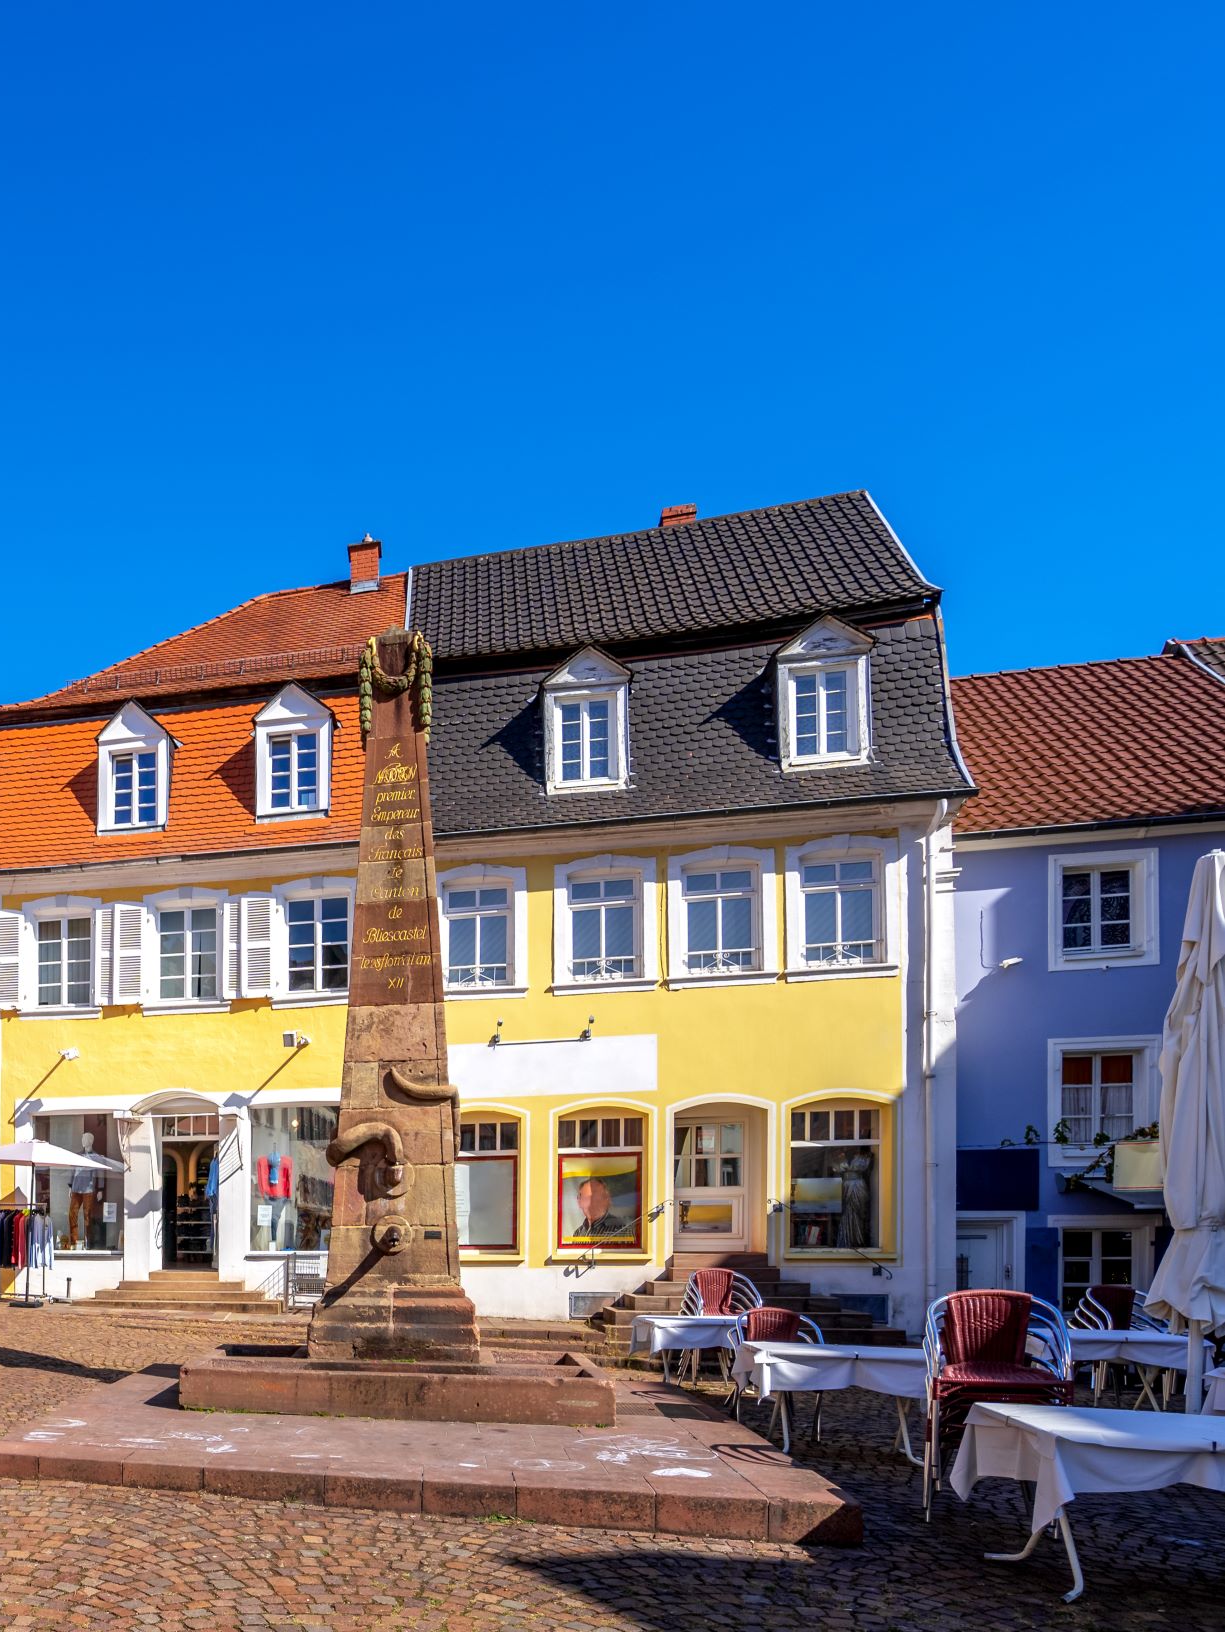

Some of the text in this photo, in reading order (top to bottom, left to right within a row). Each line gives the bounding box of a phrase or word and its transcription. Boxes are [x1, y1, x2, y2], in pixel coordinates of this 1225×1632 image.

[370, 806, 420, 823] Empereur
[384, 826, 406, 840] des
[388, 905, 404, 919] de
[362, 925, 427, 944] Bliescastel
